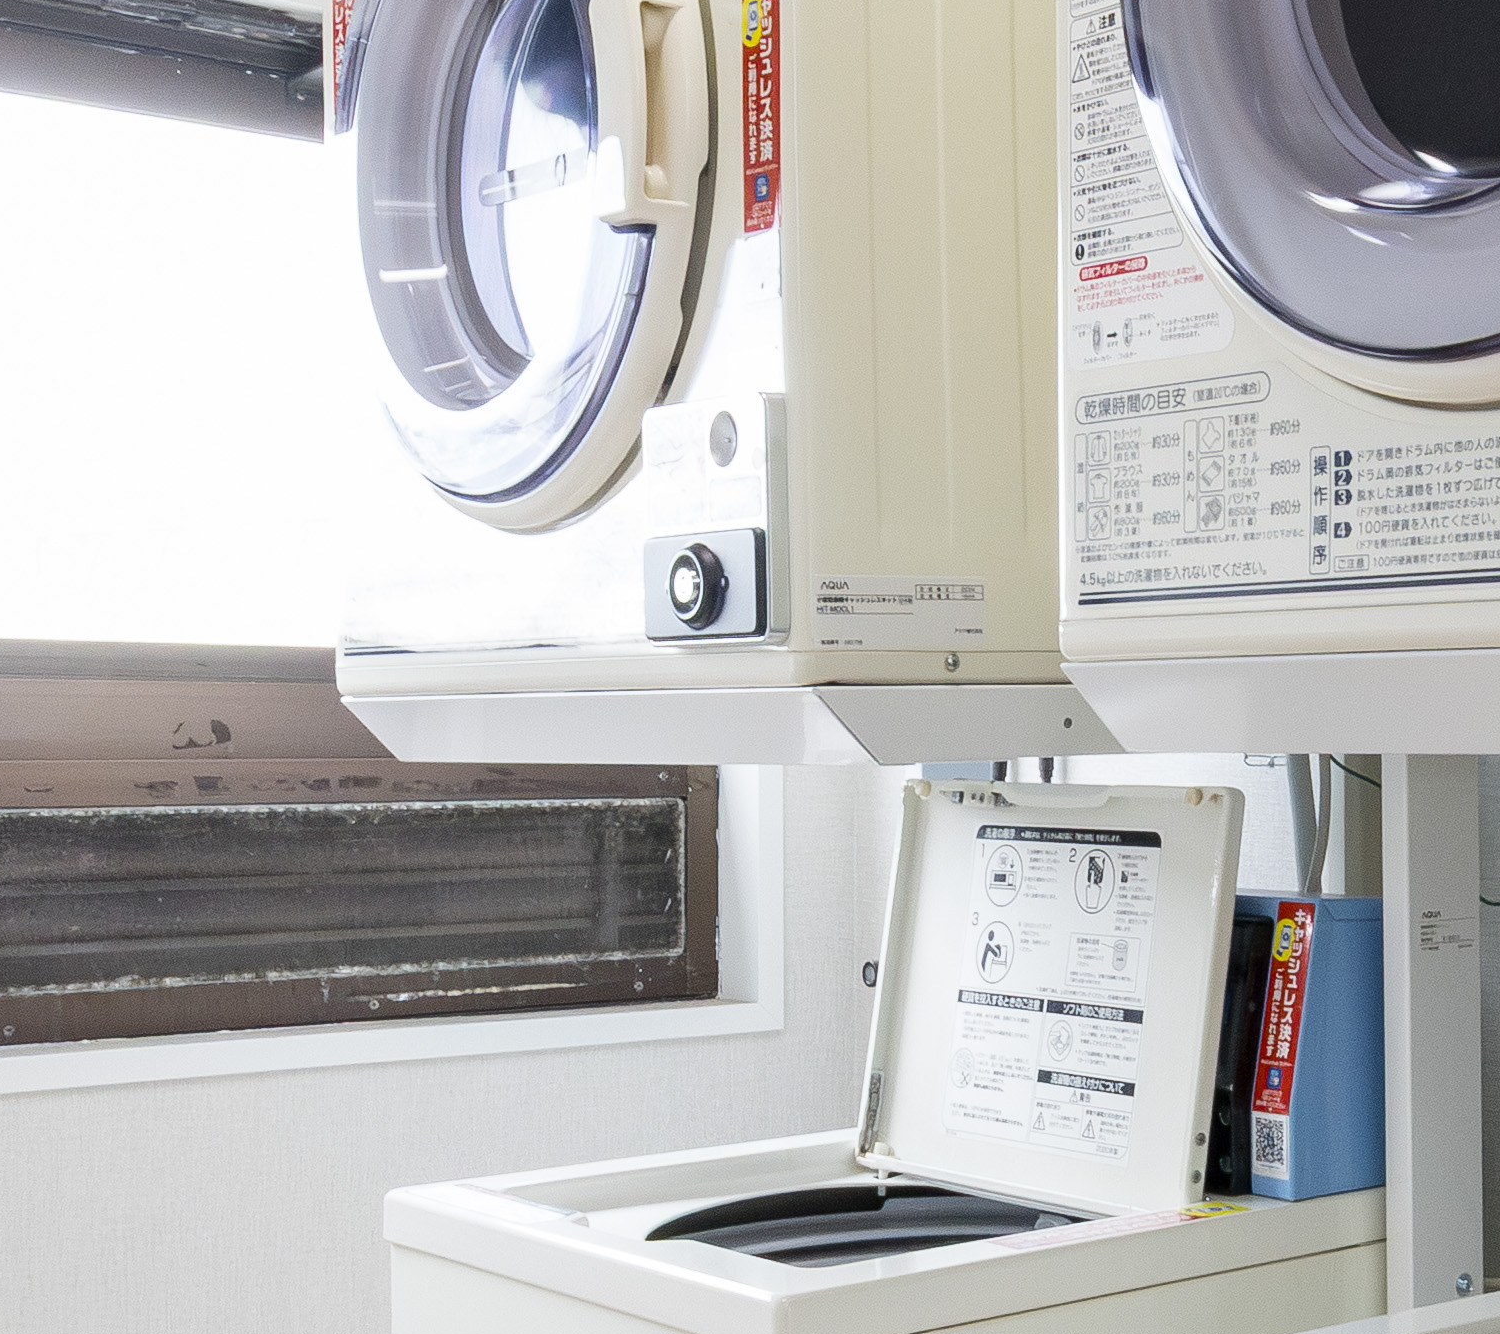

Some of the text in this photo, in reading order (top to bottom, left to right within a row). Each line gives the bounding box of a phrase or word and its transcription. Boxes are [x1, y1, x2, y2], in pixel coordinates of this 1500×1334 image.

[1083, 387, 1187, 419] 乾燥時間の目安
[1311, 453, 1330, 567] 操作順序
[821, 580, 850, 592] AQUA
[1275, 908, 1307, 1060] キャッシュレス決済
